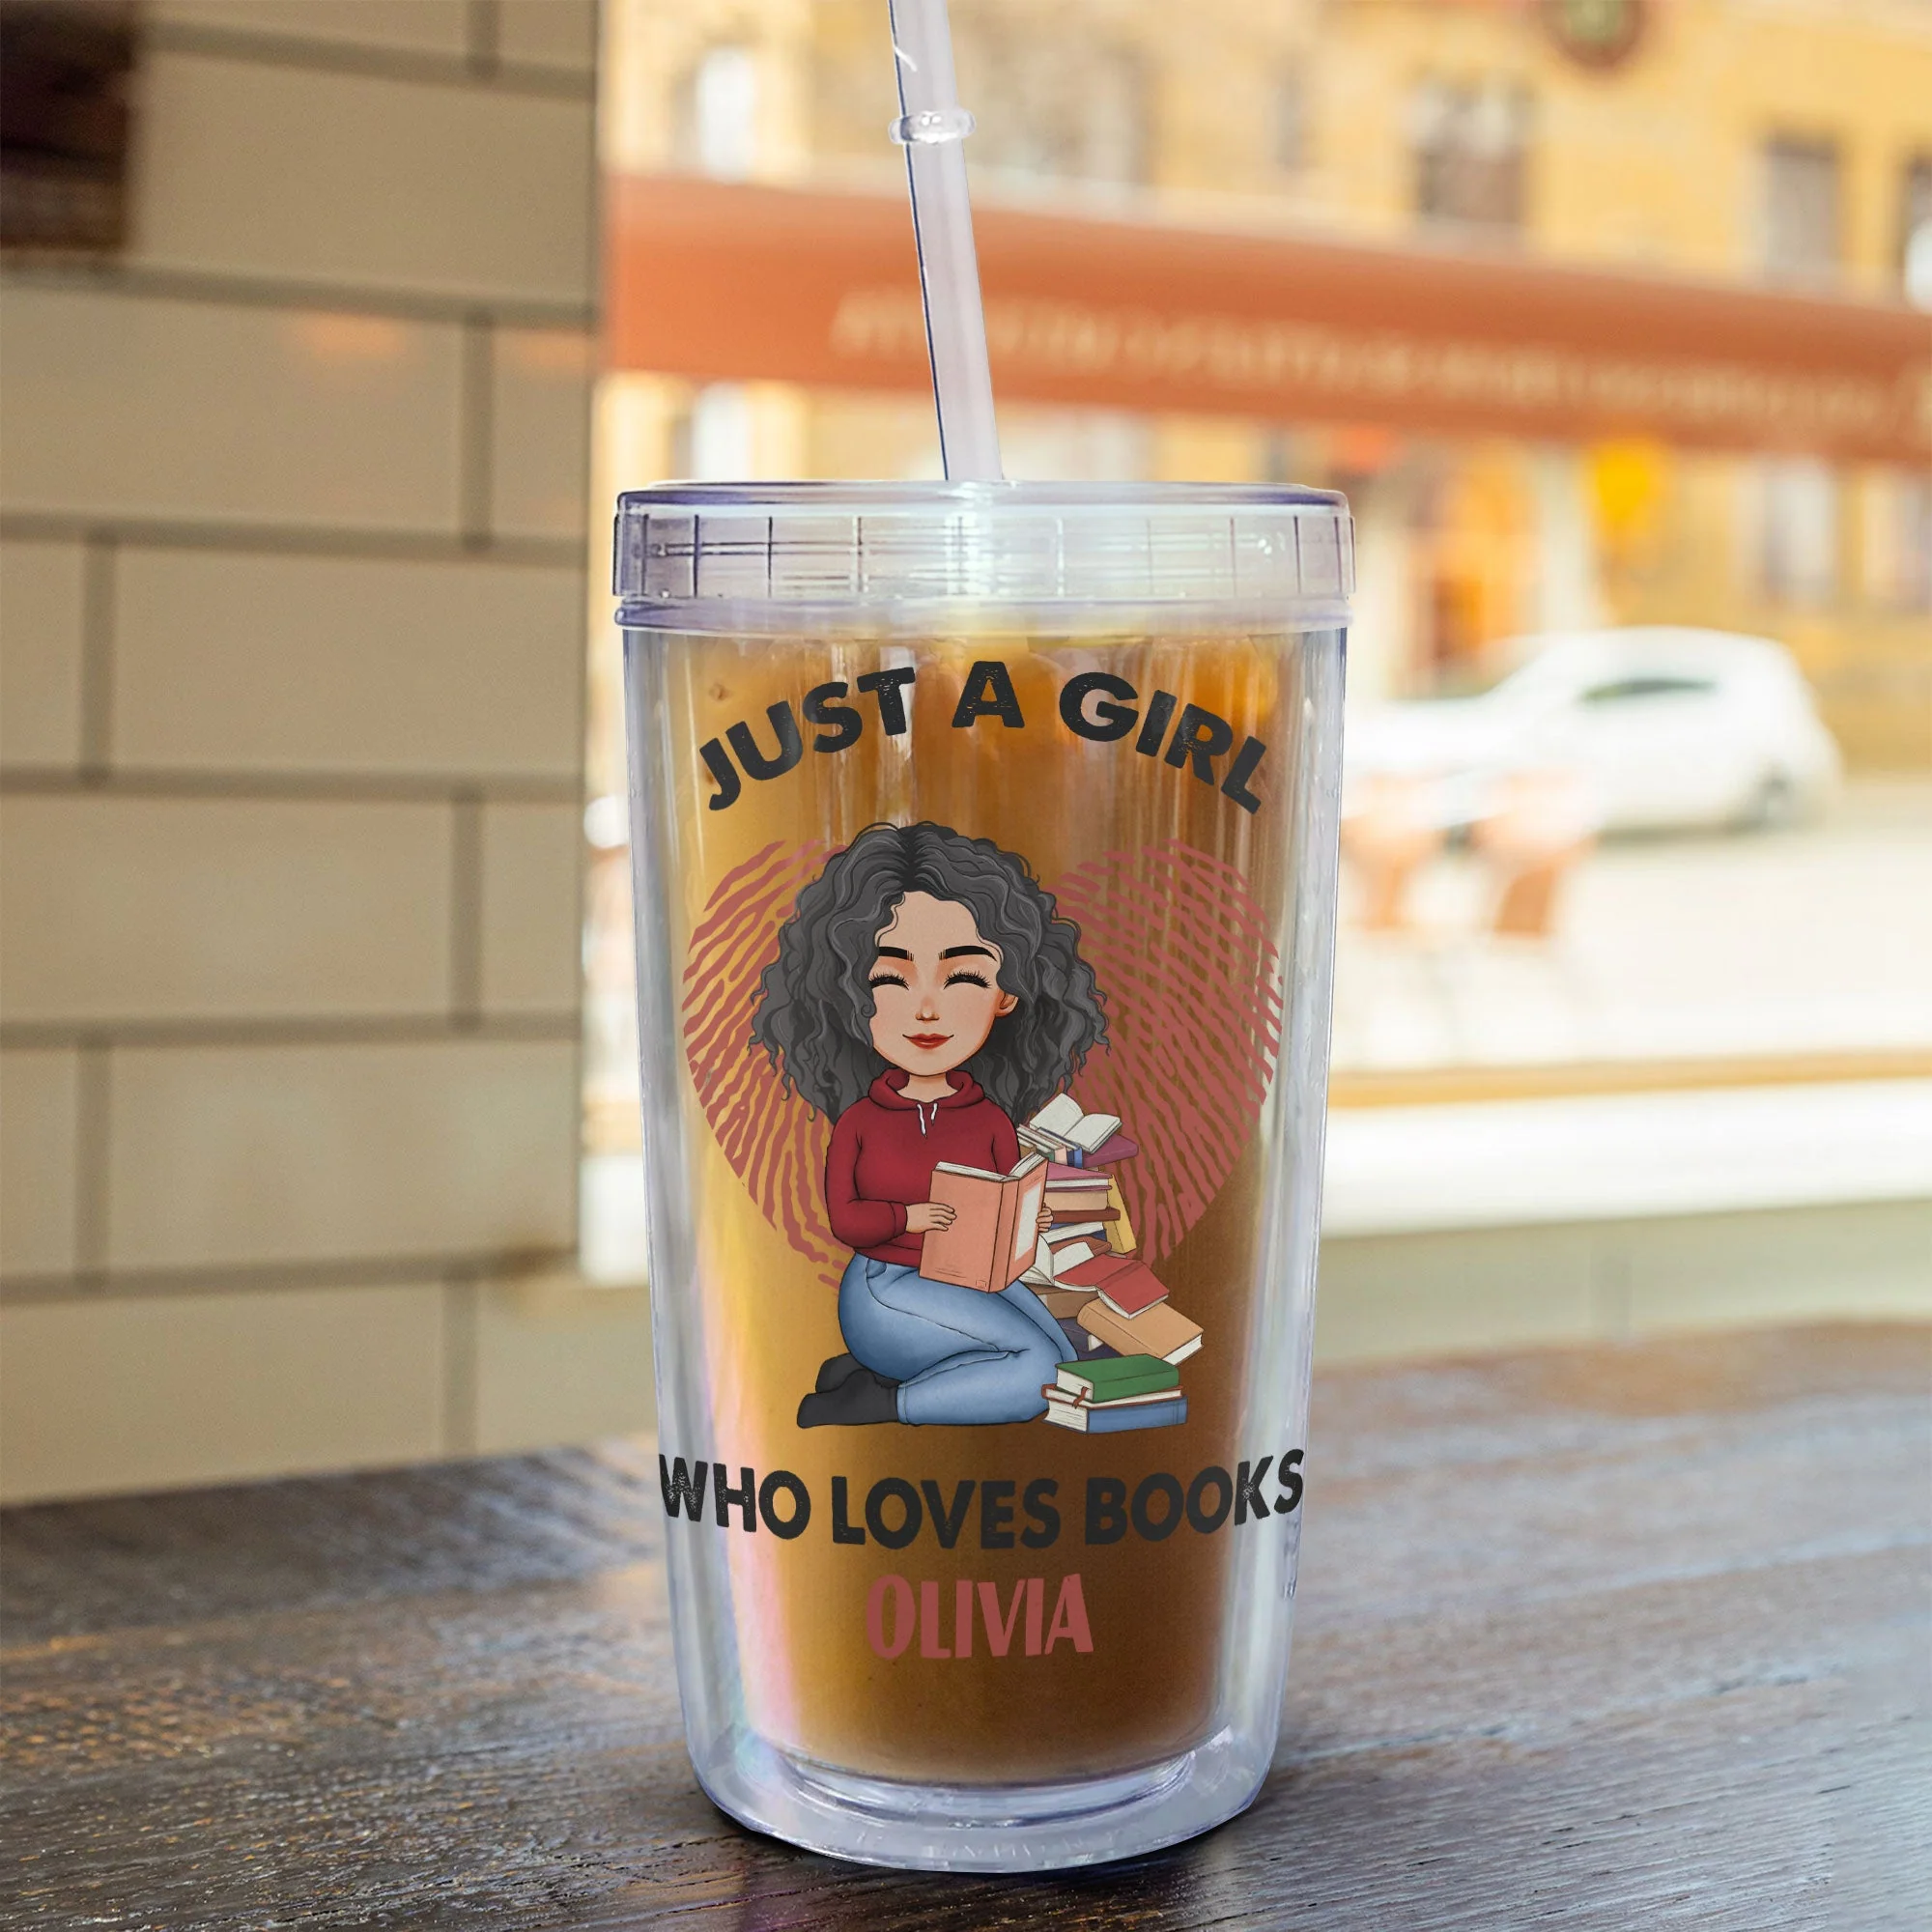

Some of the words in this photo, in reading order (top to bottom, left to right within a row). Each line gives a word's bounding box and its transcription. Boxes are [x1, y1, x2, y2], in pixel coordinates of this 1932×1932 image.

[698, 667, 916, 810] JUST
[952, 661, 1025, 728] A
[1059, 672, 1266, 813] GIRL
[659, 1453, 811, 1540] WHO
[832, 1476, 1059, 1549] LOVES
[1085, 1448, 1304, 1545] BOOKS
[867, 1574, 1094, 1660] OLIVIA
